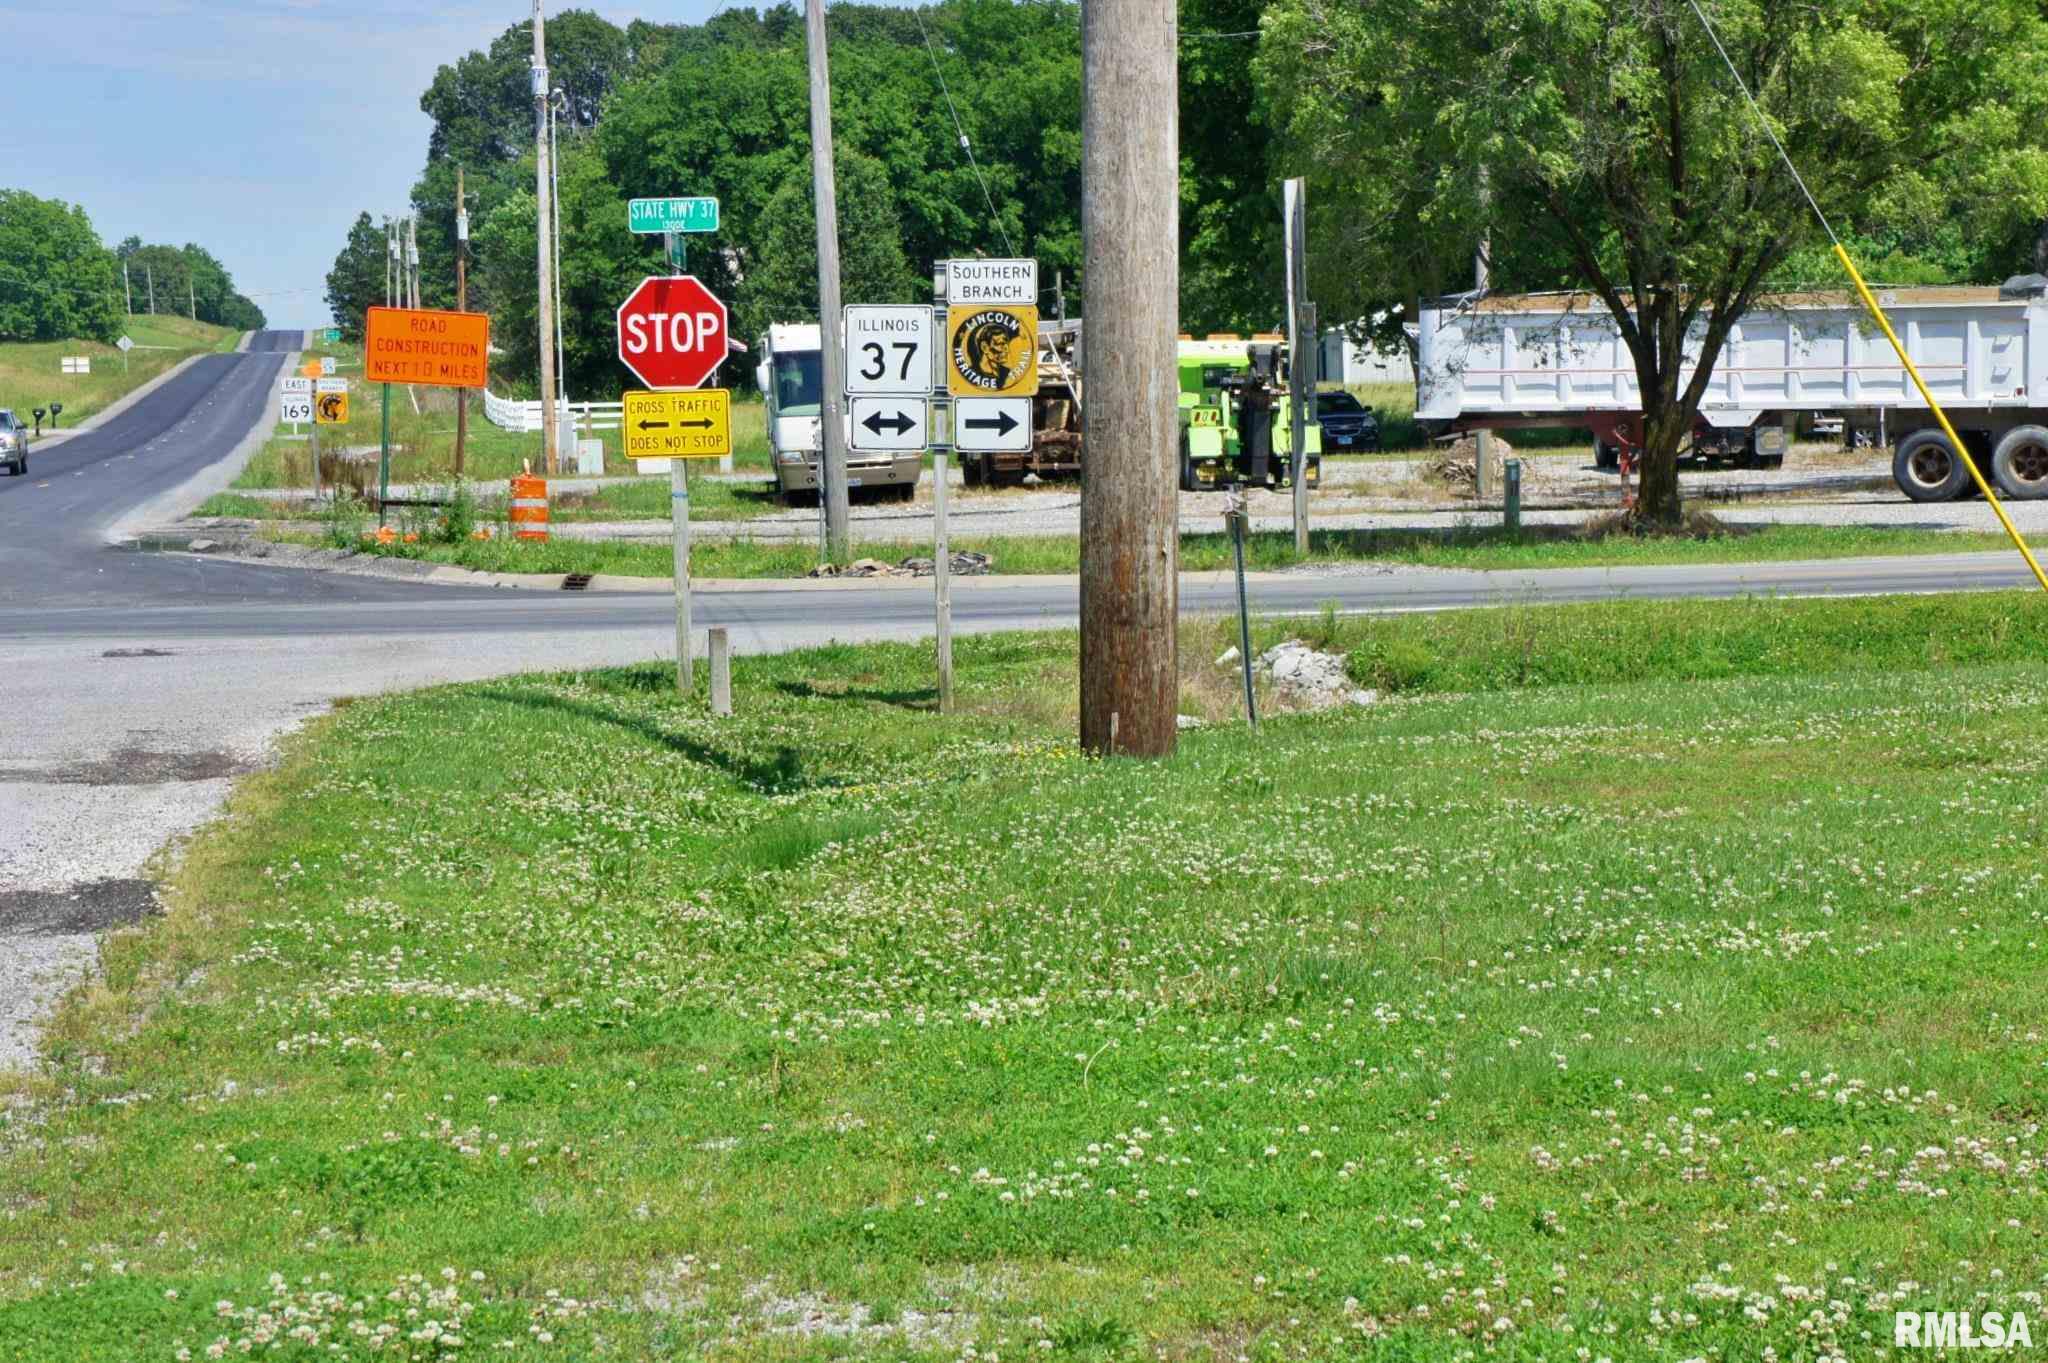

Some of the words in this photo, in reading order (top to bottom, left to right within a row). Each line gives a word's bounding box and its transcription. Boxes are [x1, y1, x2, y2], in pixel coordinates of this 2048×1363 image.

[631, 201, 665, 220] STATE
[670, 201, 695, 219] HWY
[700, 201, 714, 218] 37
[953, 265, 1031, 279] SOUTHERN
[962, 285, 1022, 298] BRANCH
[410, 318, 447, 333] ROAD
[858, 319, 920, 332] ILLINOIS
[965, 311, 1019, 332] LINCOLN
[626, 312, 719, 354] STOP
[376, 337, 478, 357] CONSTRUCTION
[860, 342, 918, 380] 37
[954, 347, 998, 389] HERITAGE
[375, 360, 408, 375] NEXT
[440, 363, 479, 379] MILES
[286, 380, 306, 389] EAST
[283, 404, 310, 418] 169
[629, 400, 665, 414] CROSS
[672, 400, 721, 414] TRAFFIC
[631, 437, 660, 450] DOES
[665, 436, 687, 449] NOT
[694, 435, 723, 448] STOP
